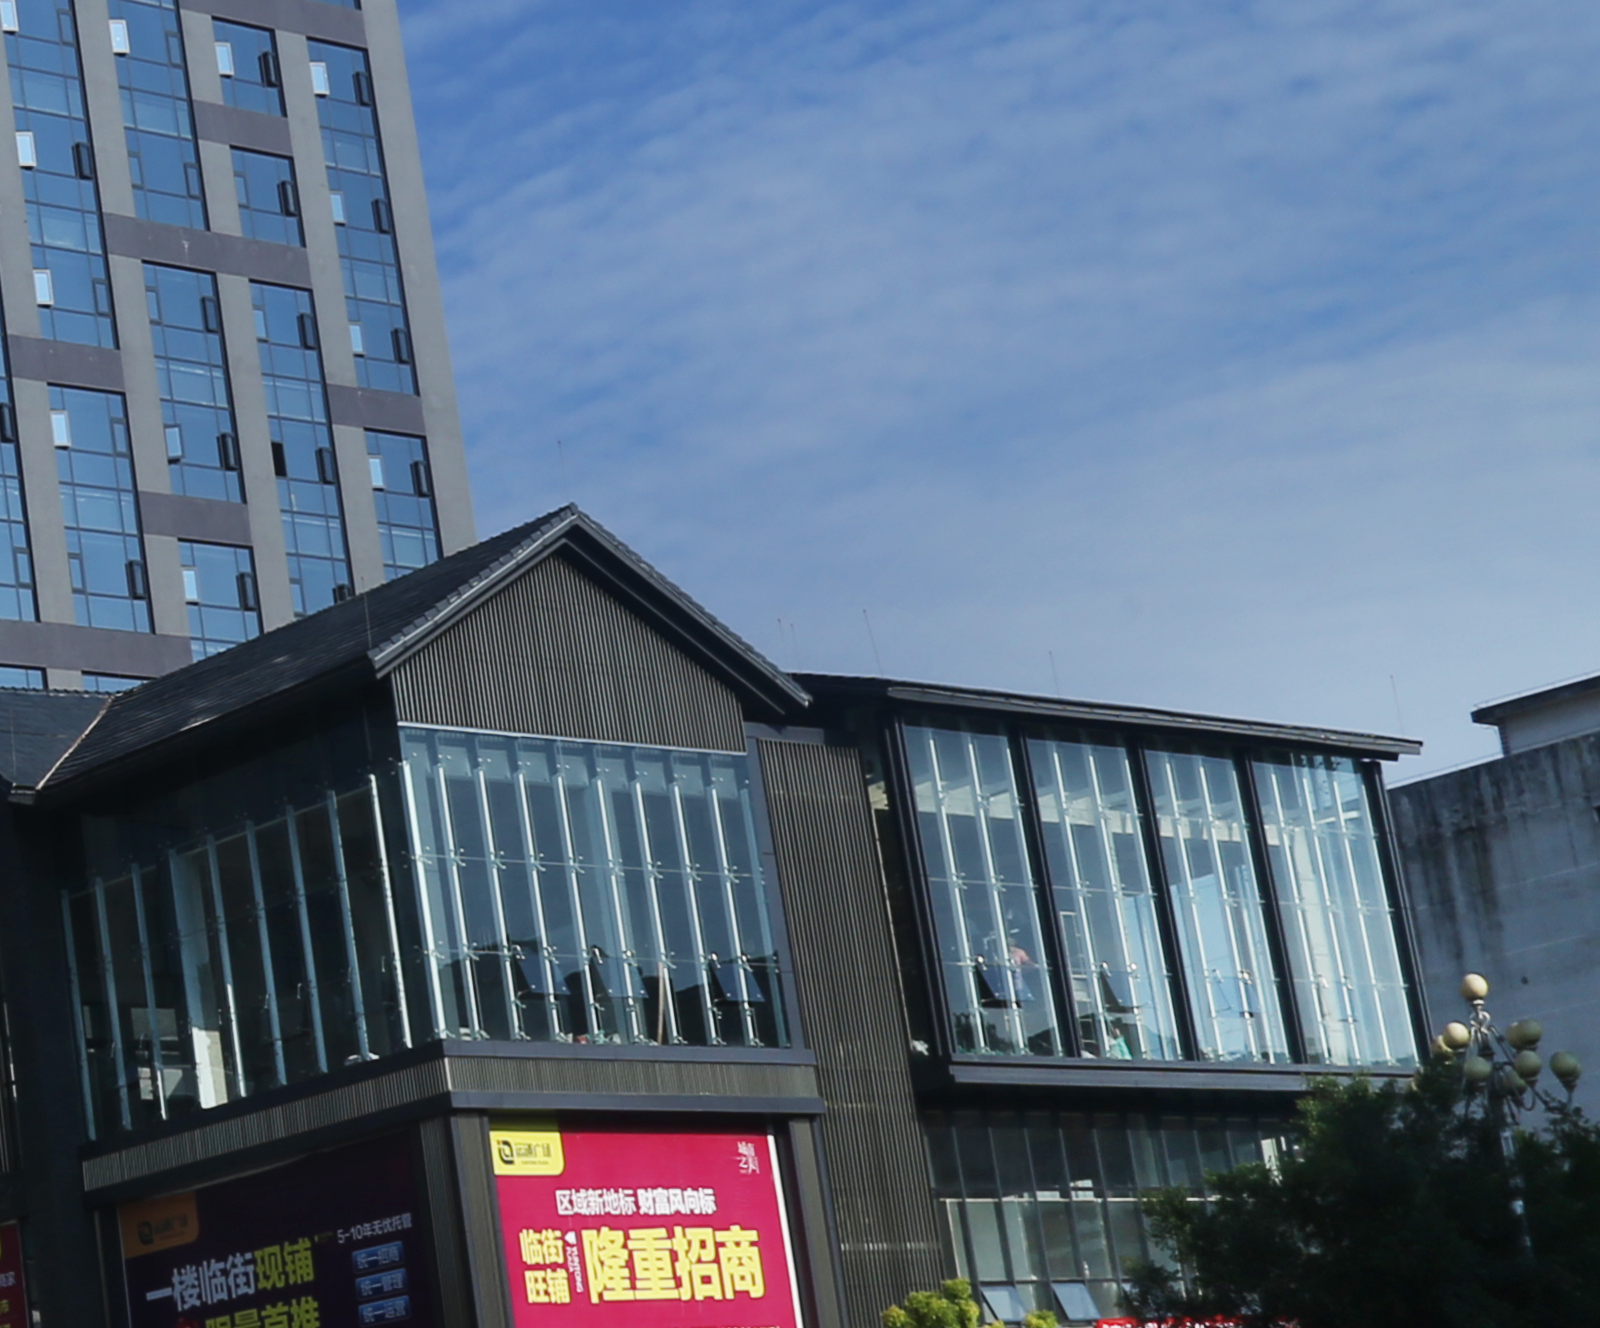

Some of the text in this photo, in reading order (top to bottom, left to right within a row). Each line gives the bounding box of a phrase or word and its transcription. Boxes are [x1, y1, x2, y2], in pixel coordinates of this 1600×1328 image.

[555, 1187, 717, 1215] 区域新地标 财富风向标
[357, 1246, 399, 1269] 统一招商
[519, 1228, 565, 1265] 临街
[146, 1238, 314, 1311] 一楼临街现铺
[581, 1225, 765, 1304] 隆重招商
[360, 1272, 404, 1296] 统一管理
[524, 1268, 571, 1304] 旺铺
[363, 1300, 407, 1324] 统一运营
